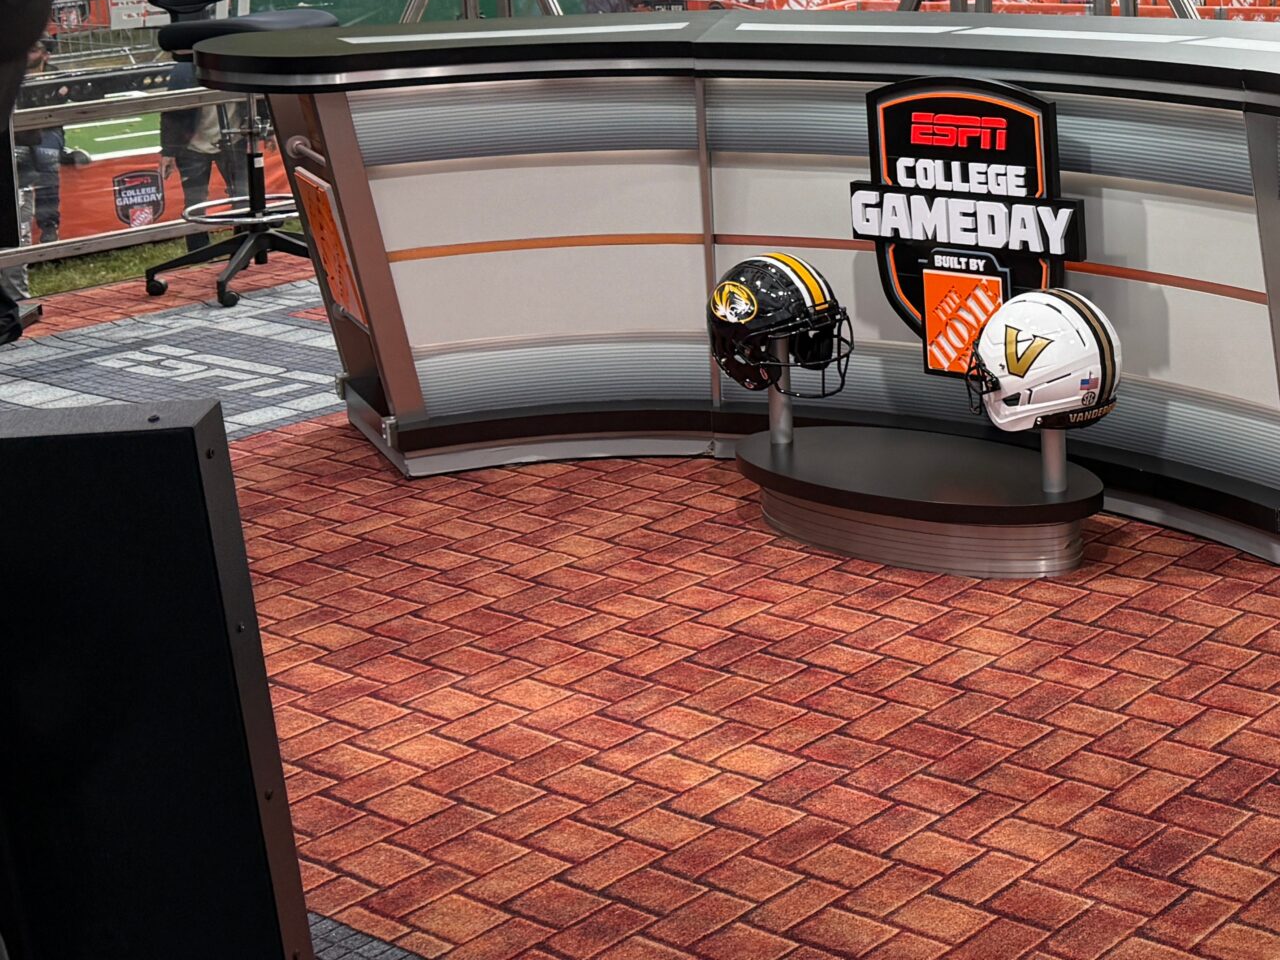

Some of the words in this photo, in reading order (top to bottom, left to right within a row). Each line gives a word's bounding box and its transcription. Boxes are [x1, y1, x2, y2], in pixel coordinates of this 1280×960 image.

[910, 112, 1007, 151] ESPN
[121, 186, 157, 197] COLLEGE
[896, 157, 1027, 197] COLLEGE
[116, 193, 163, 206] GAMEDAY
[851, 190, 1074, 255] GAMEDAY
[933, 254, 961, 271] BUILT
[967, 257, 986, 272] BY
[933, 286, 962, 321] THE
[928, 278, 1002, 372] HOME
[84, 344, 337, 397] ESPN
